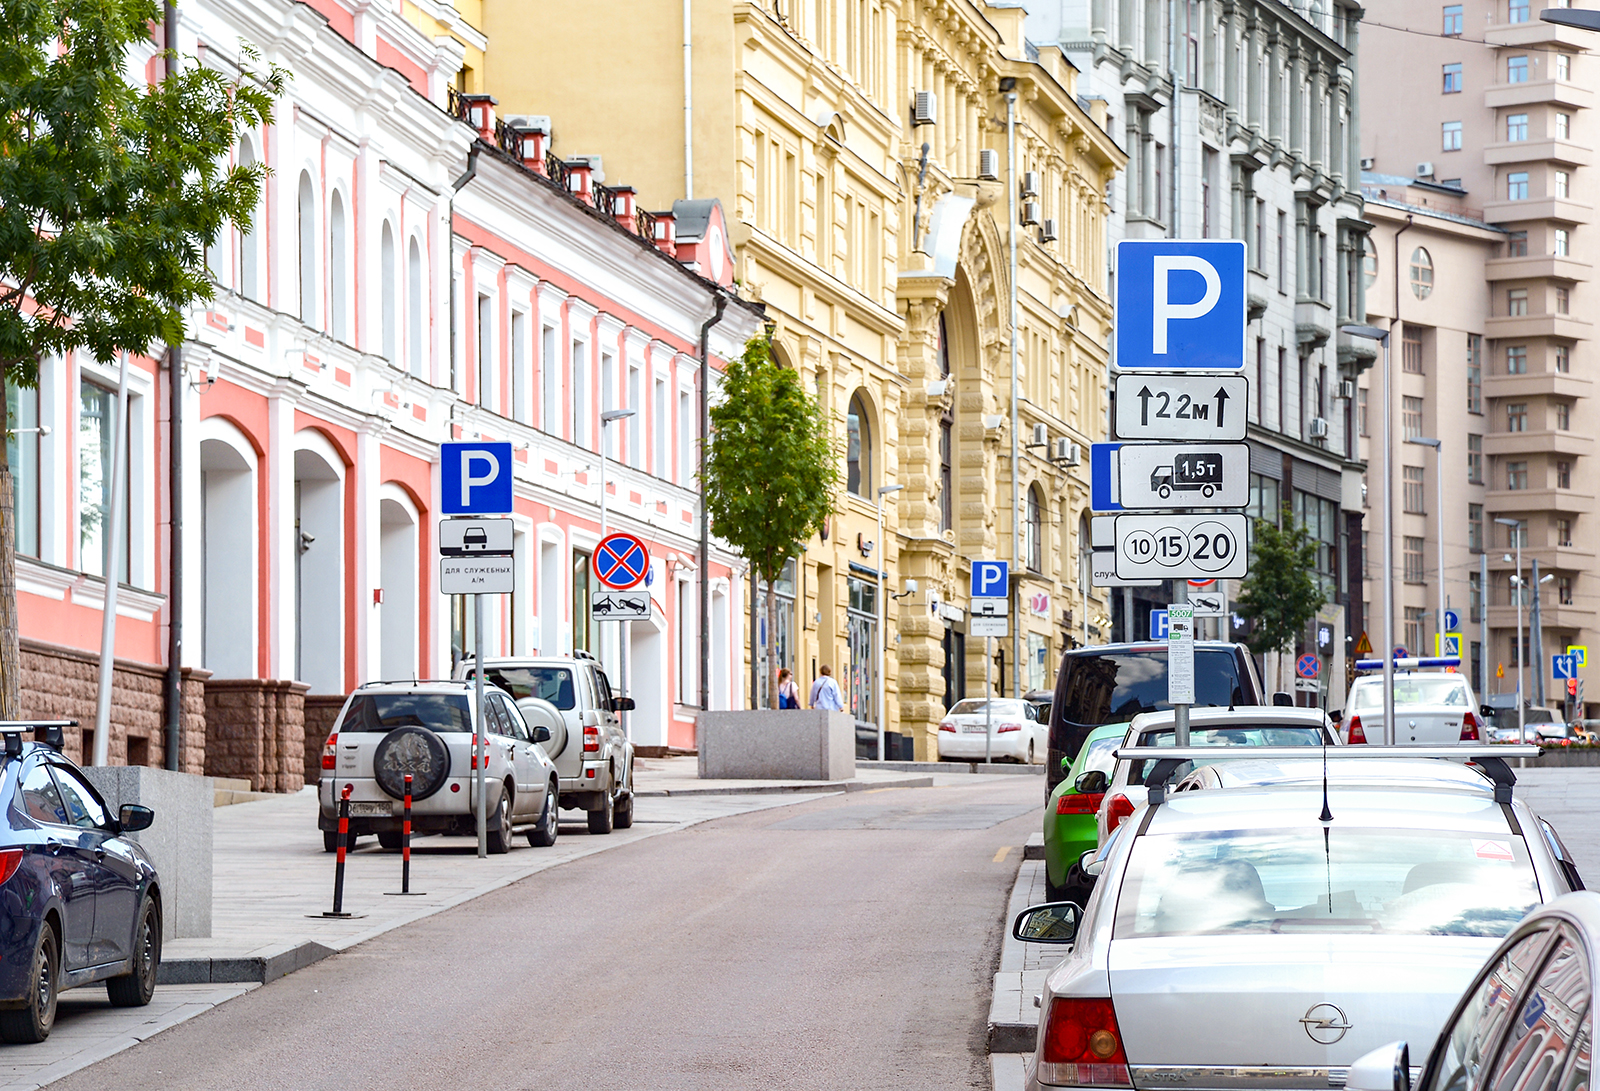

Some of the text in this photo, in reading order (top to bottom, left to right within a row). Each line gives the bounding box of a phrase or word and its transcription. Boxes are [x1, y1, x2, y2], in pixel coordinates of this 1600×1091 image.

[1153, 255, 1222, 355] P
[461, 450, 500, 506] P
[1131, 533, 1231, 560] 10 15 20
[445, 567, 511, 575] ДЛЯ СЛУЖЕБНЫХ
[981, 564, 1002, 594] P
[1094, 571, 1117, 579] служ
[1142, 1072, 1188, 1083] ASTRA
